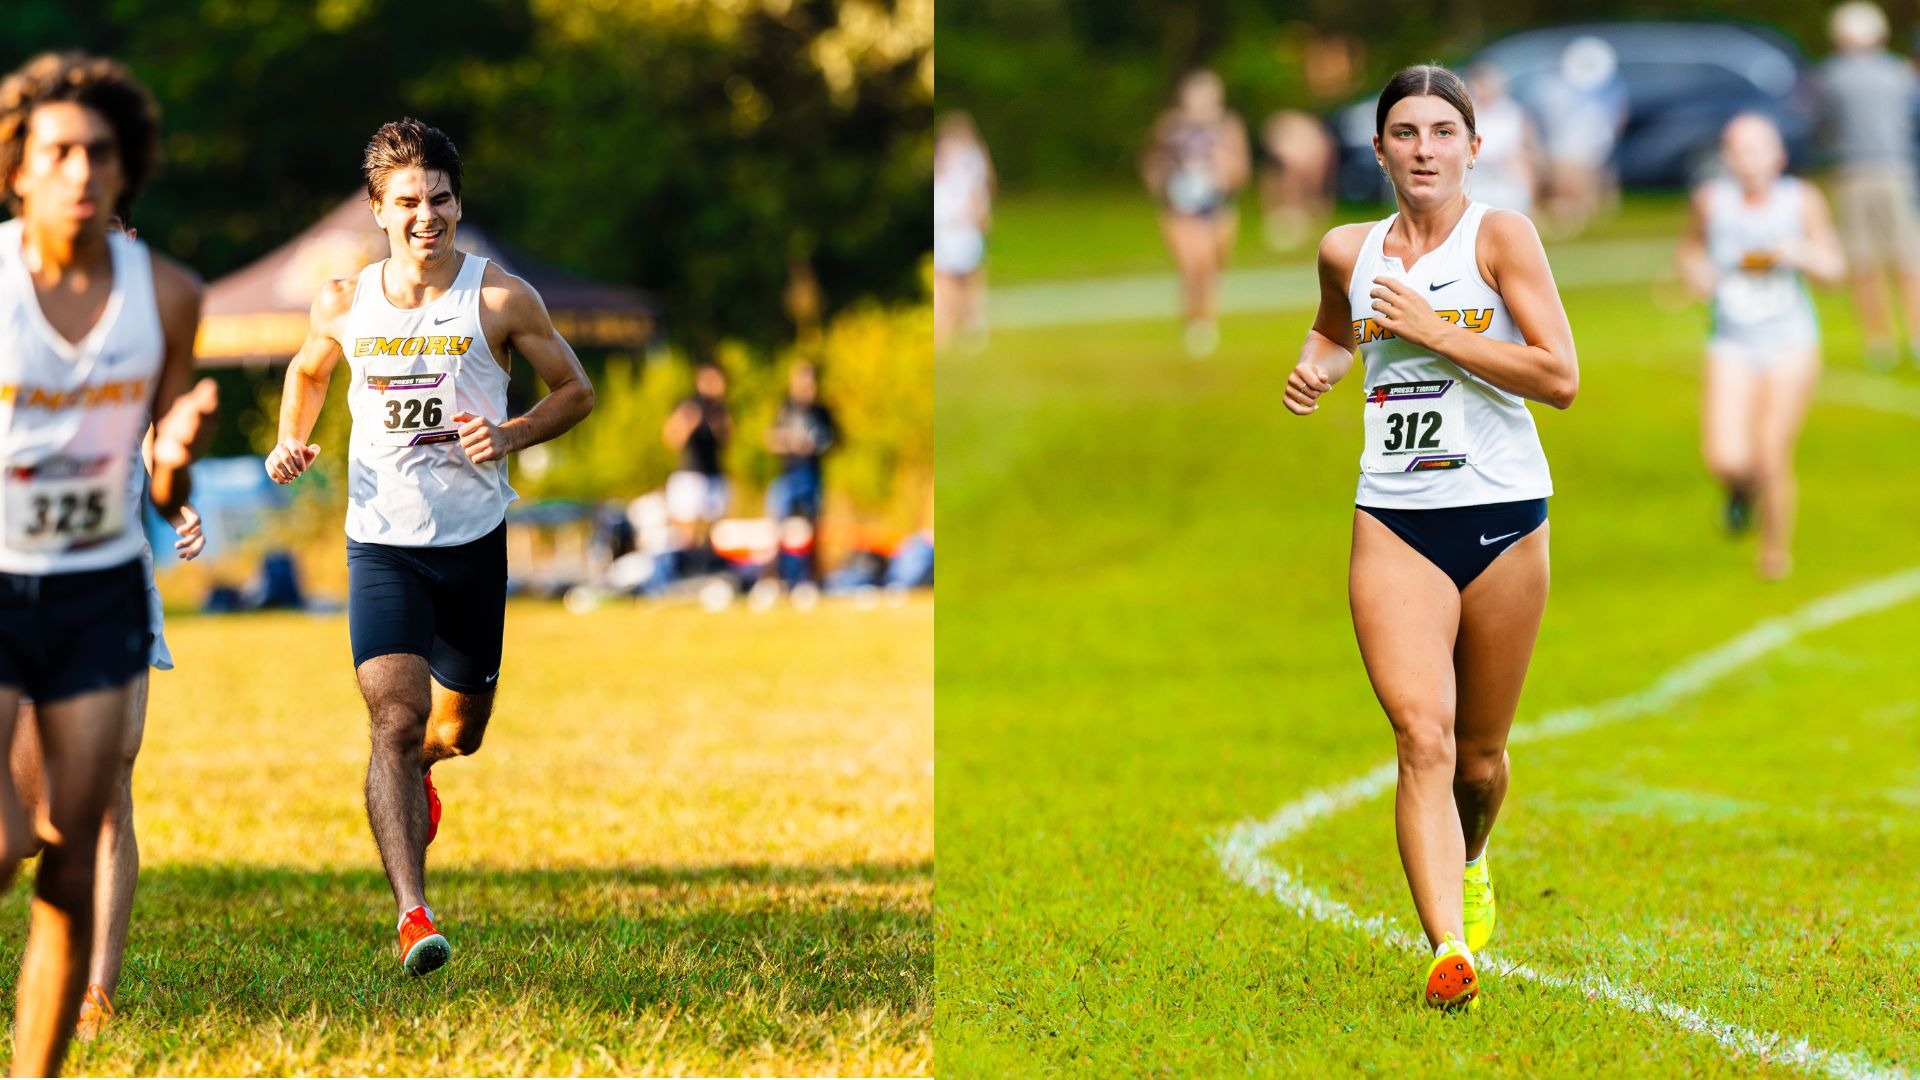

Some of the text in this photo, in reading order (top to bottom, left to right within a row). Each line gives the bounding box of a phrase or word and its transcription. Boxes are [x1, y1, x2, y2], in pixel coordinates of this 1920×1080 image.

[1351, 308, 1495, 345] EMRY
[354, 336, 473, 357] EMORY
[1390, 385, 1440, 395] XPRESS TIMING
[384, 397, 443, 429] 326
[1384, 411, 1443, 451] 312
[26, 491, 105, 536] 325
